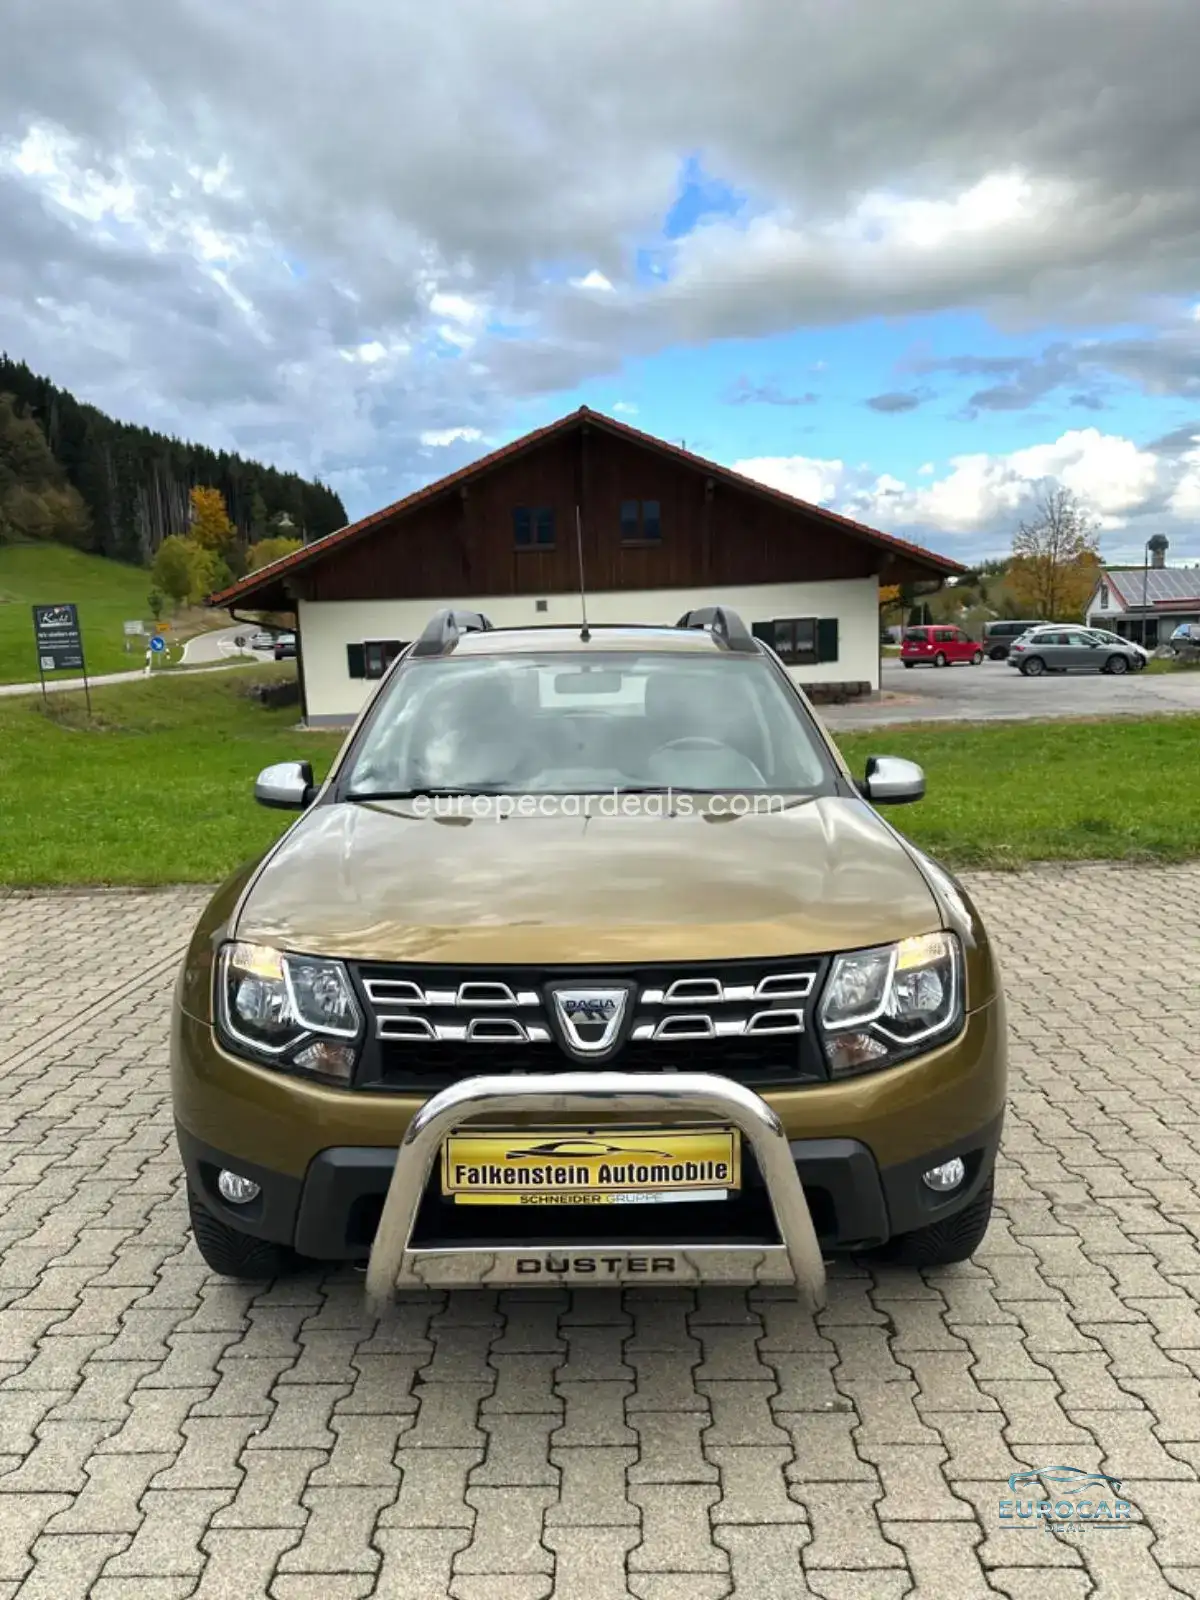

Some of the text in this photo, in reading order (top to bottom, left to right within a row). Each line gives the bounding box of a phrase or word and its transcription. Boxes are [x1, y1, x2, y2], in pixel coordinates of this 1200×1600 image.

[566, 999, 616, 1009] DACIA
[455, 1160, 728, 1185] Falkenstein Automobile
[519, 1192, 664, 1205] SCHNEIDER GRUPPE
[516, 1257, 676, 1275] DUSTER
